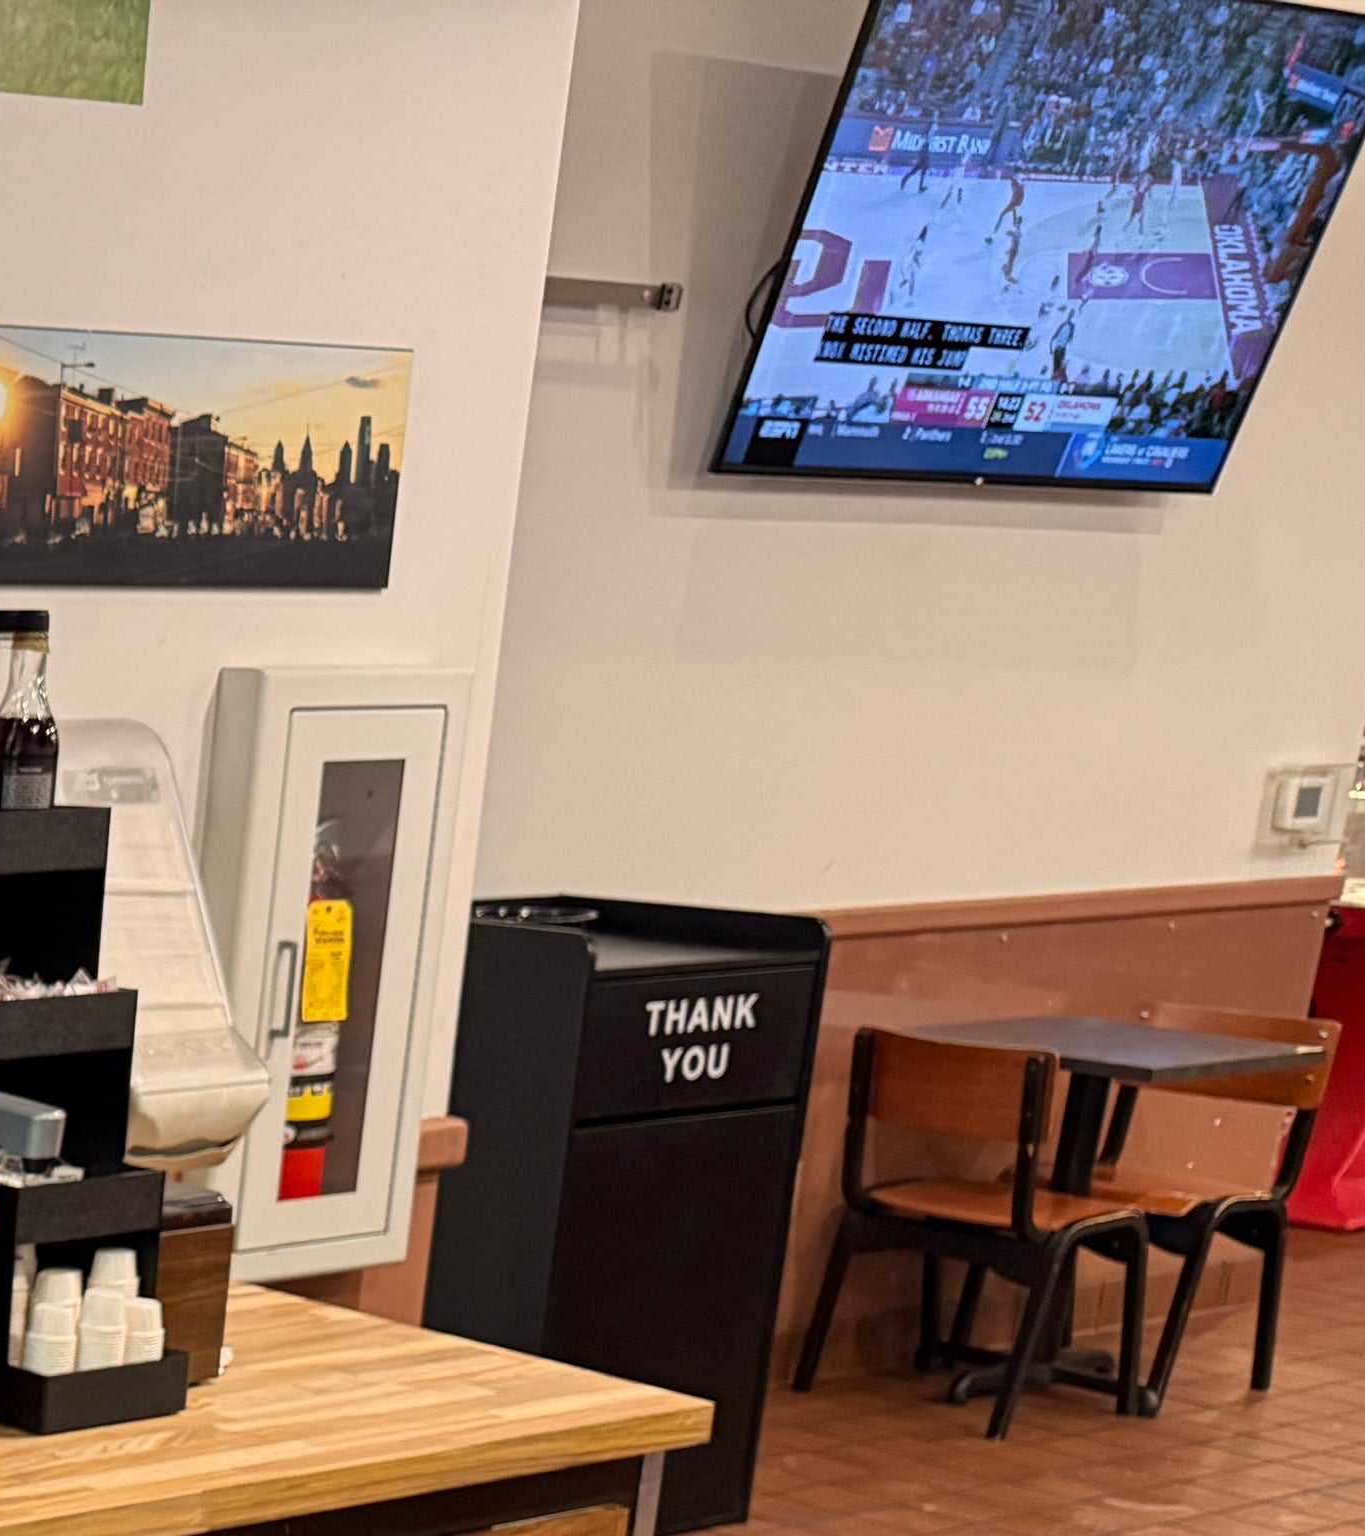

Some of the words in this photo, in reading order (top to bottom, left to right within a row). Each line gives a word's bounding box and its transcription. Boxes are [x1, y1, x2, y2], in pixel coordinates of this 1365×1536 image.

[1024, 401, 1047, 422] 52
[644, 993, 760, 1037] THANK
[660, 1043, 730, 1084] YOU
